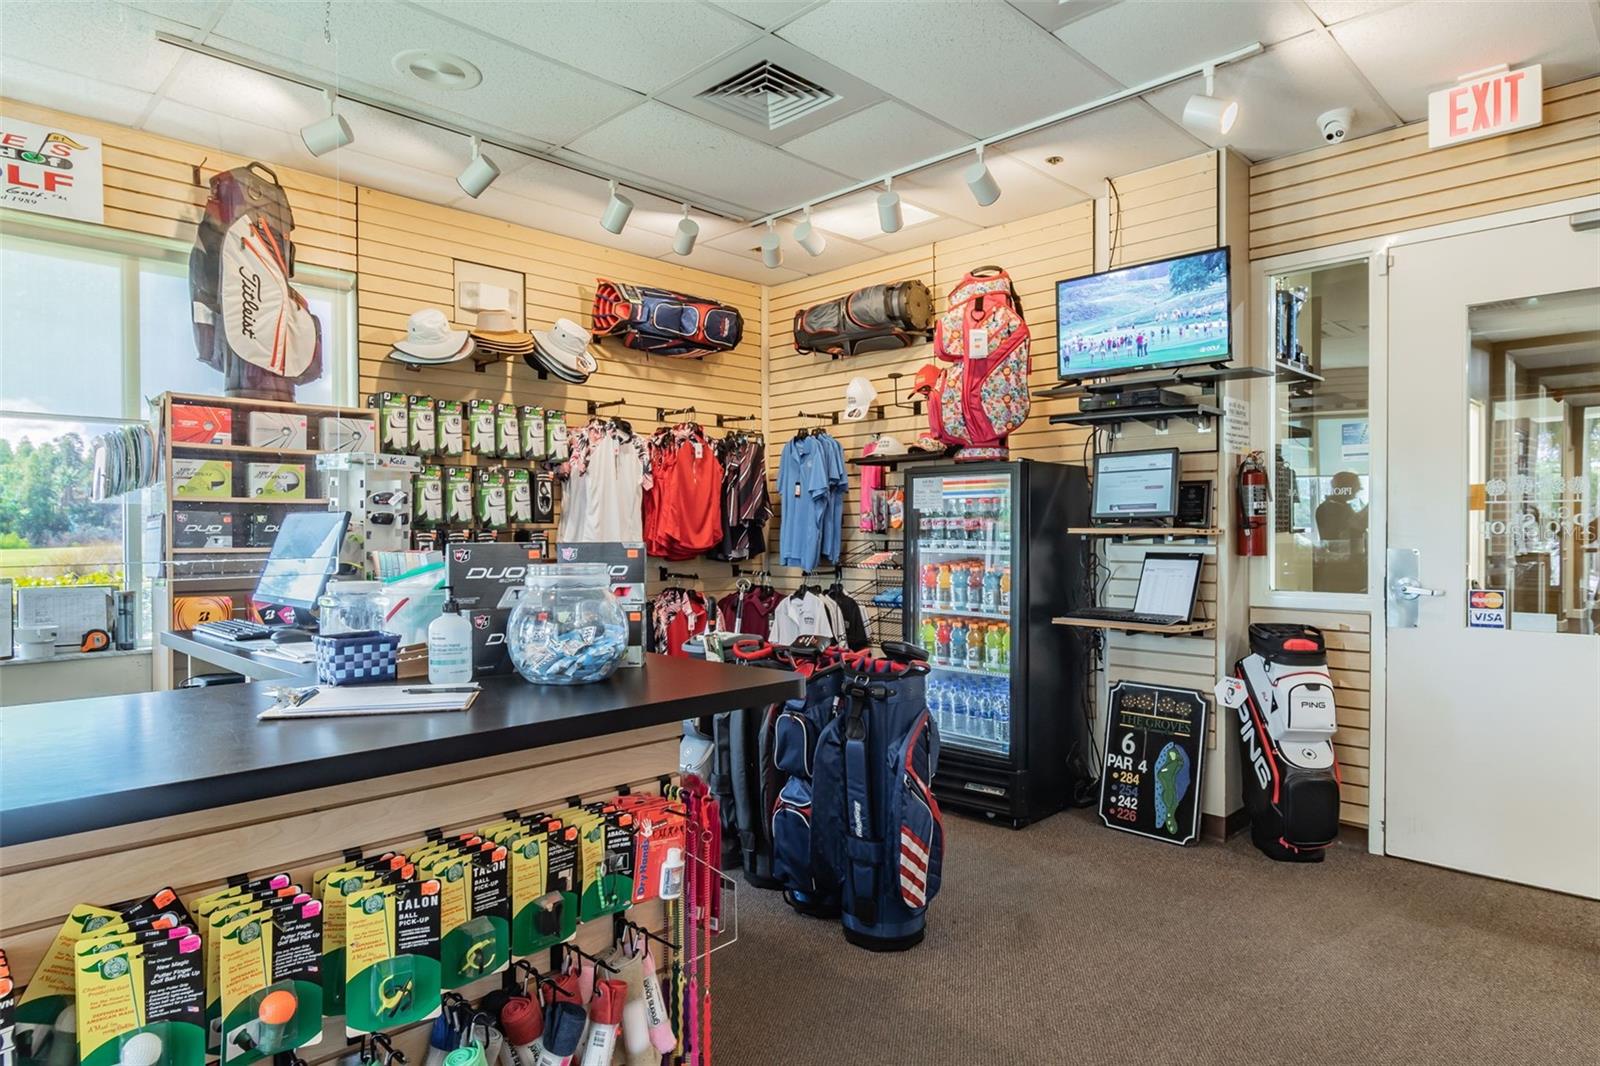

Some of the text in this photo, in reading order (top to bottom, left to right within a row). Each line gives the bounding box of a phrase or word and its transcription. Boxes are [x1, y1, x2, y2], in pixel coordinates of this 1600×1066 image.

[1449, 72, 1524, 137] EXIT
[239, 266, 262, 340] Titleist
[184, 524, 222, 532] DUO
[465, 566, 525, 579] DUO
[1475, 613, 1502, 622] VISA
[1301, 701, 1326, 709] PING
[1121, 713, 1191, 734] THE GROVES
[1121, 732, 1136, 755] 6
[1107, 754, 1148, 774] PAR 4
[1120, 772, 1140, 785] 284
[1119, 784, 1139, 797] 254
[1118, 795, 1138, 810] 242
[1116, 808, 1137, 822] 226
[473, 860, 506, 878] TALON
[637, 838, 650, 895] Dry Hands
[474, 877, 490, 886] BALL
[474, 880, 499, 892] PICK-UP
[397, 895, 438, 911] TALON
[398, 917, 429, 927] PICK-UP
[399, 912, 418, 920] BALL
[280, 929, 314, 941] Putter Finger
[171, 959, 190, 968] Magic
[154, 967, 193, 980] Putter Finger
[643, 979, 661, 1025] greens towel
